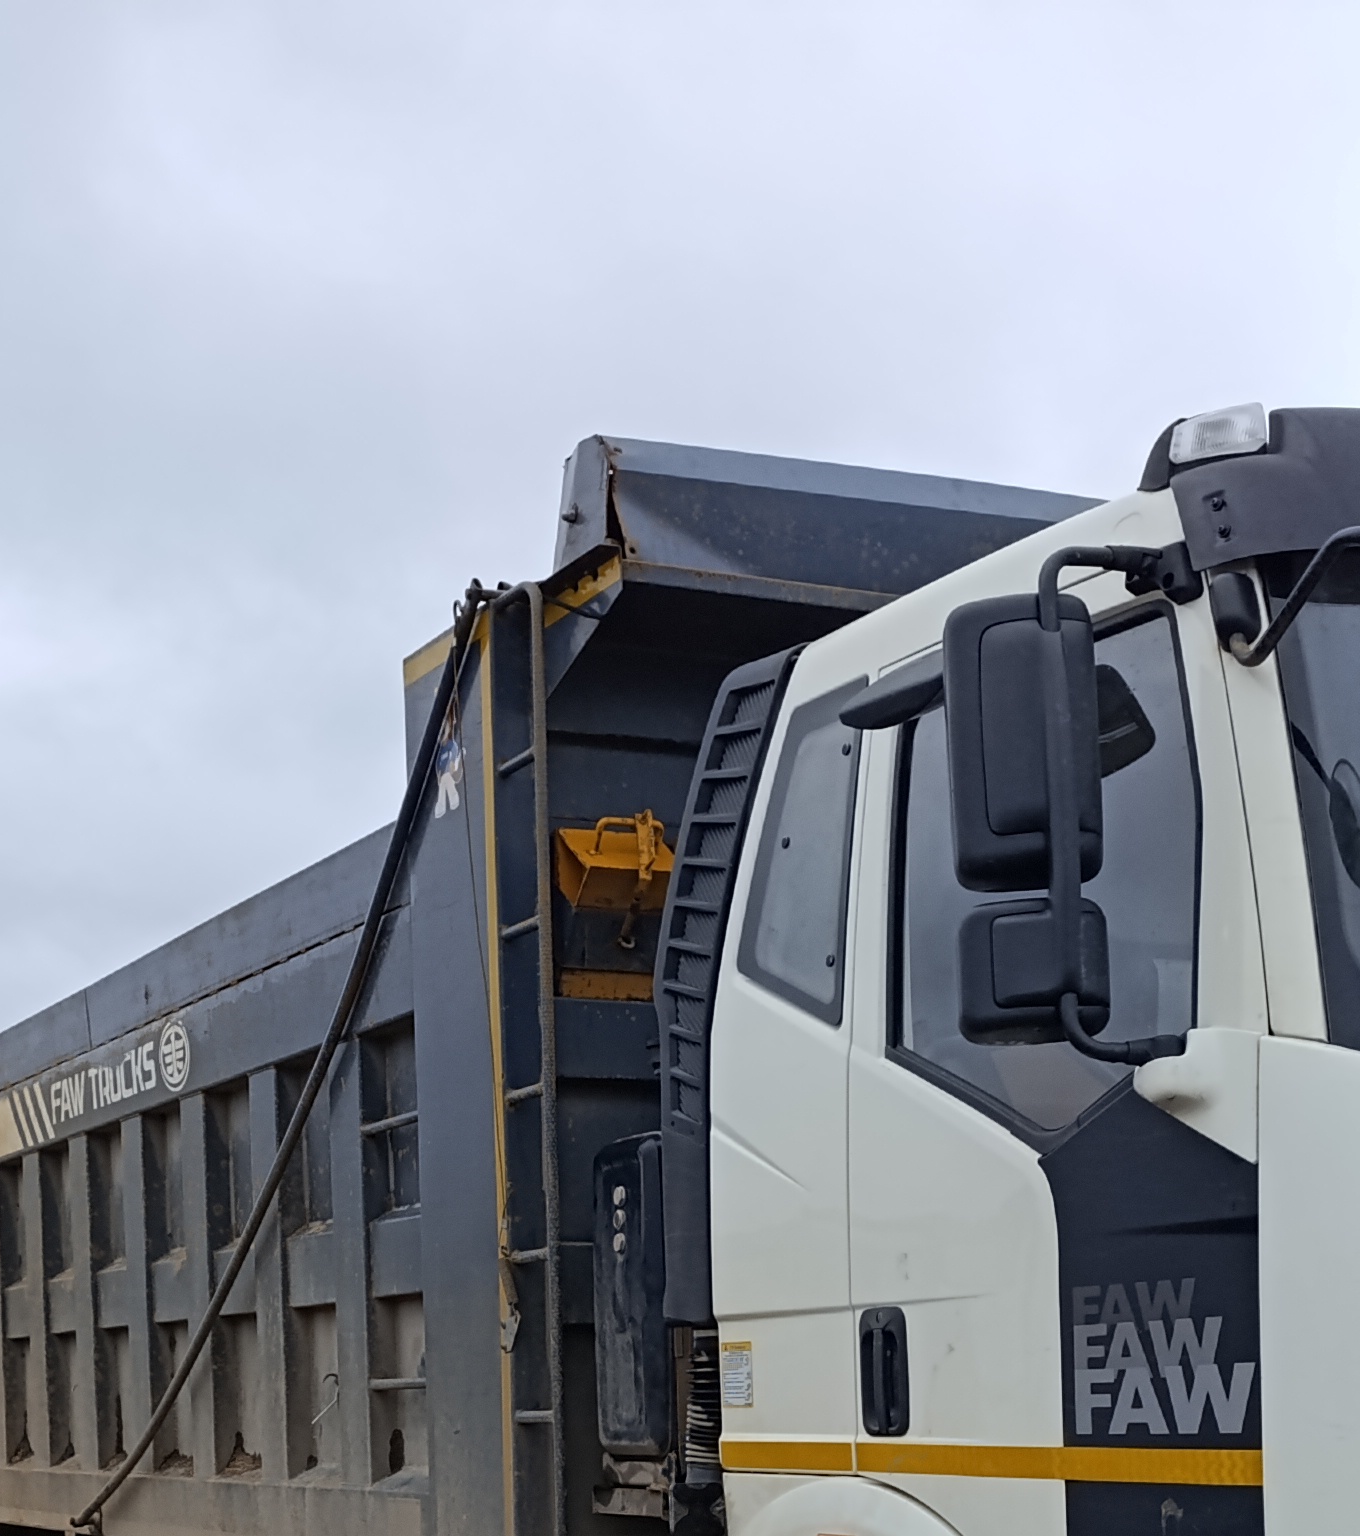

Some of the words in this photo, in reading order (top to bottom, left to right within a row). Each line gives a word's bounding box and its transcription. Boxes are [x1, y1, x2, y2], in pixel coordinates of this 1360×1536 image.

[50, 1071, 85, 1125] FAW
[88, 1041, 157, 1110] TRUCKS
[1072, 1277, 1196, 1330] FAW
[1073, 1316, 1223, 1378] FAW
[1074, 1362, 1257, 1435] FAW
